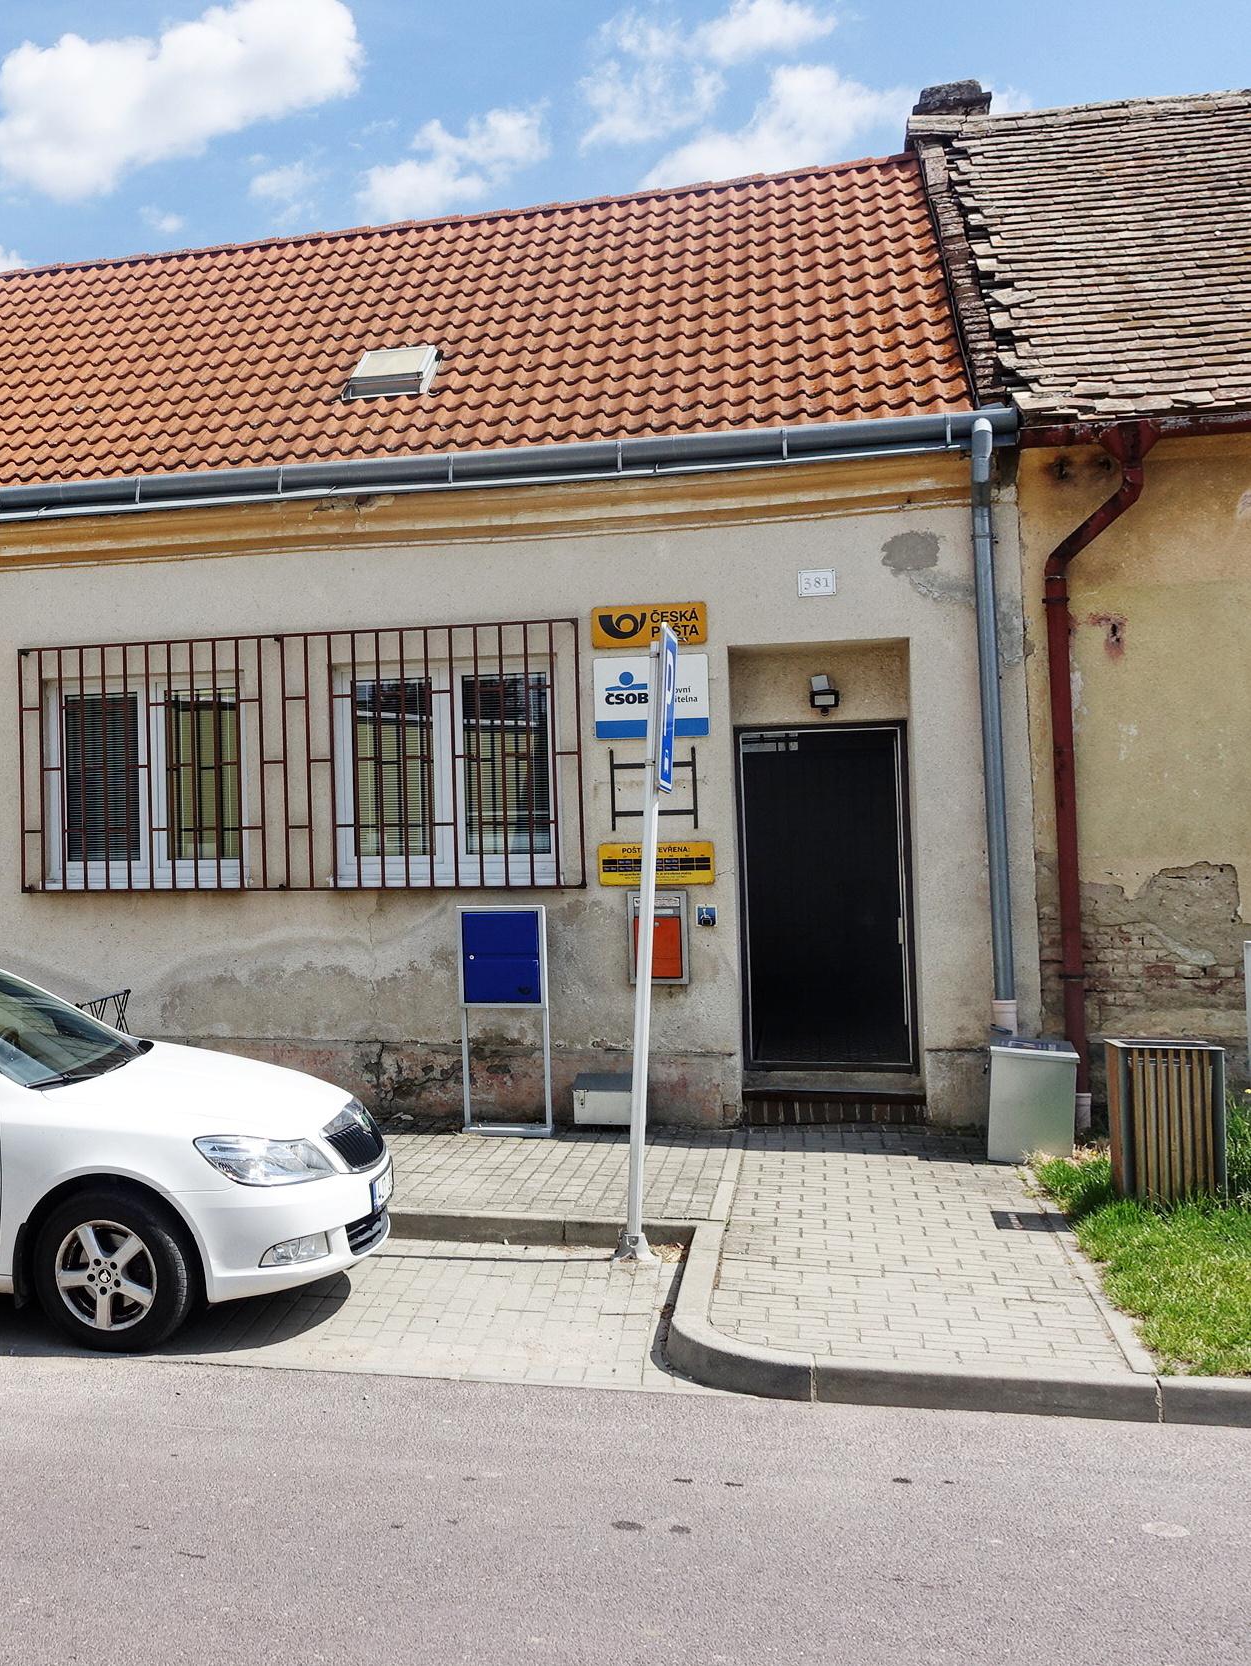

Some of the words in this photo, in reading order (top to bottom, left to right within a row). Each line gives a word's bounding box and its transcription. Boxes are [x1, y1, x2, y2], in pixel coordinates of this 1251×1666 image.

[804, 577, 830, 590] 381
[650, 607, 699, 623] ČESKÁ
[651, 623, 699, 638] PŠTA
[605, 692, 649, 705] ČSOB
[621, 846, 642, 854] POŠT
[658, 845, 690, 853] EVŘENA:
